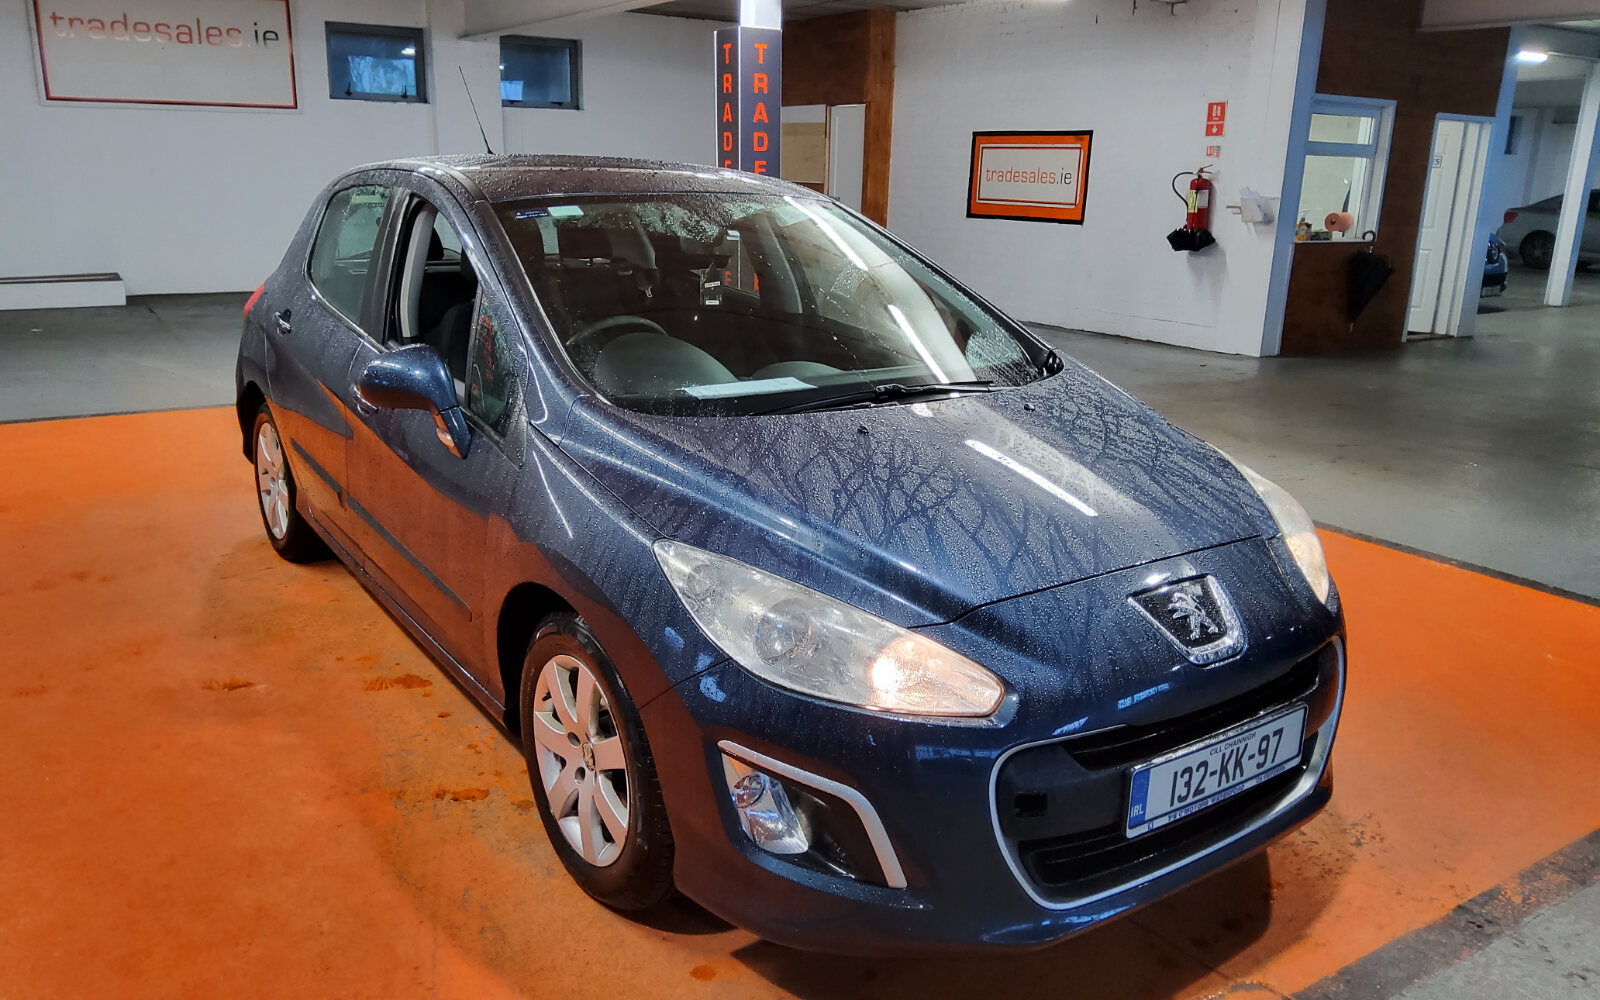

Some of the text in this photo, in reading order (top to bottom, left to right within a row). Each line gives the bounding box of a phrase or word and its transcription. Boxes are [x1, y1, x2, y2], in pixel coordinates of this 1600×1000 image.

[50, 11, 280, 48] tradesales.ie
[985, 166, 1073, 185] tradesales.ie
[1209, 746, 1222, 756] CILL
[1169, 727, 1284, 808] 132-KK-97
[1130, 803, 1145, 819] IRL
